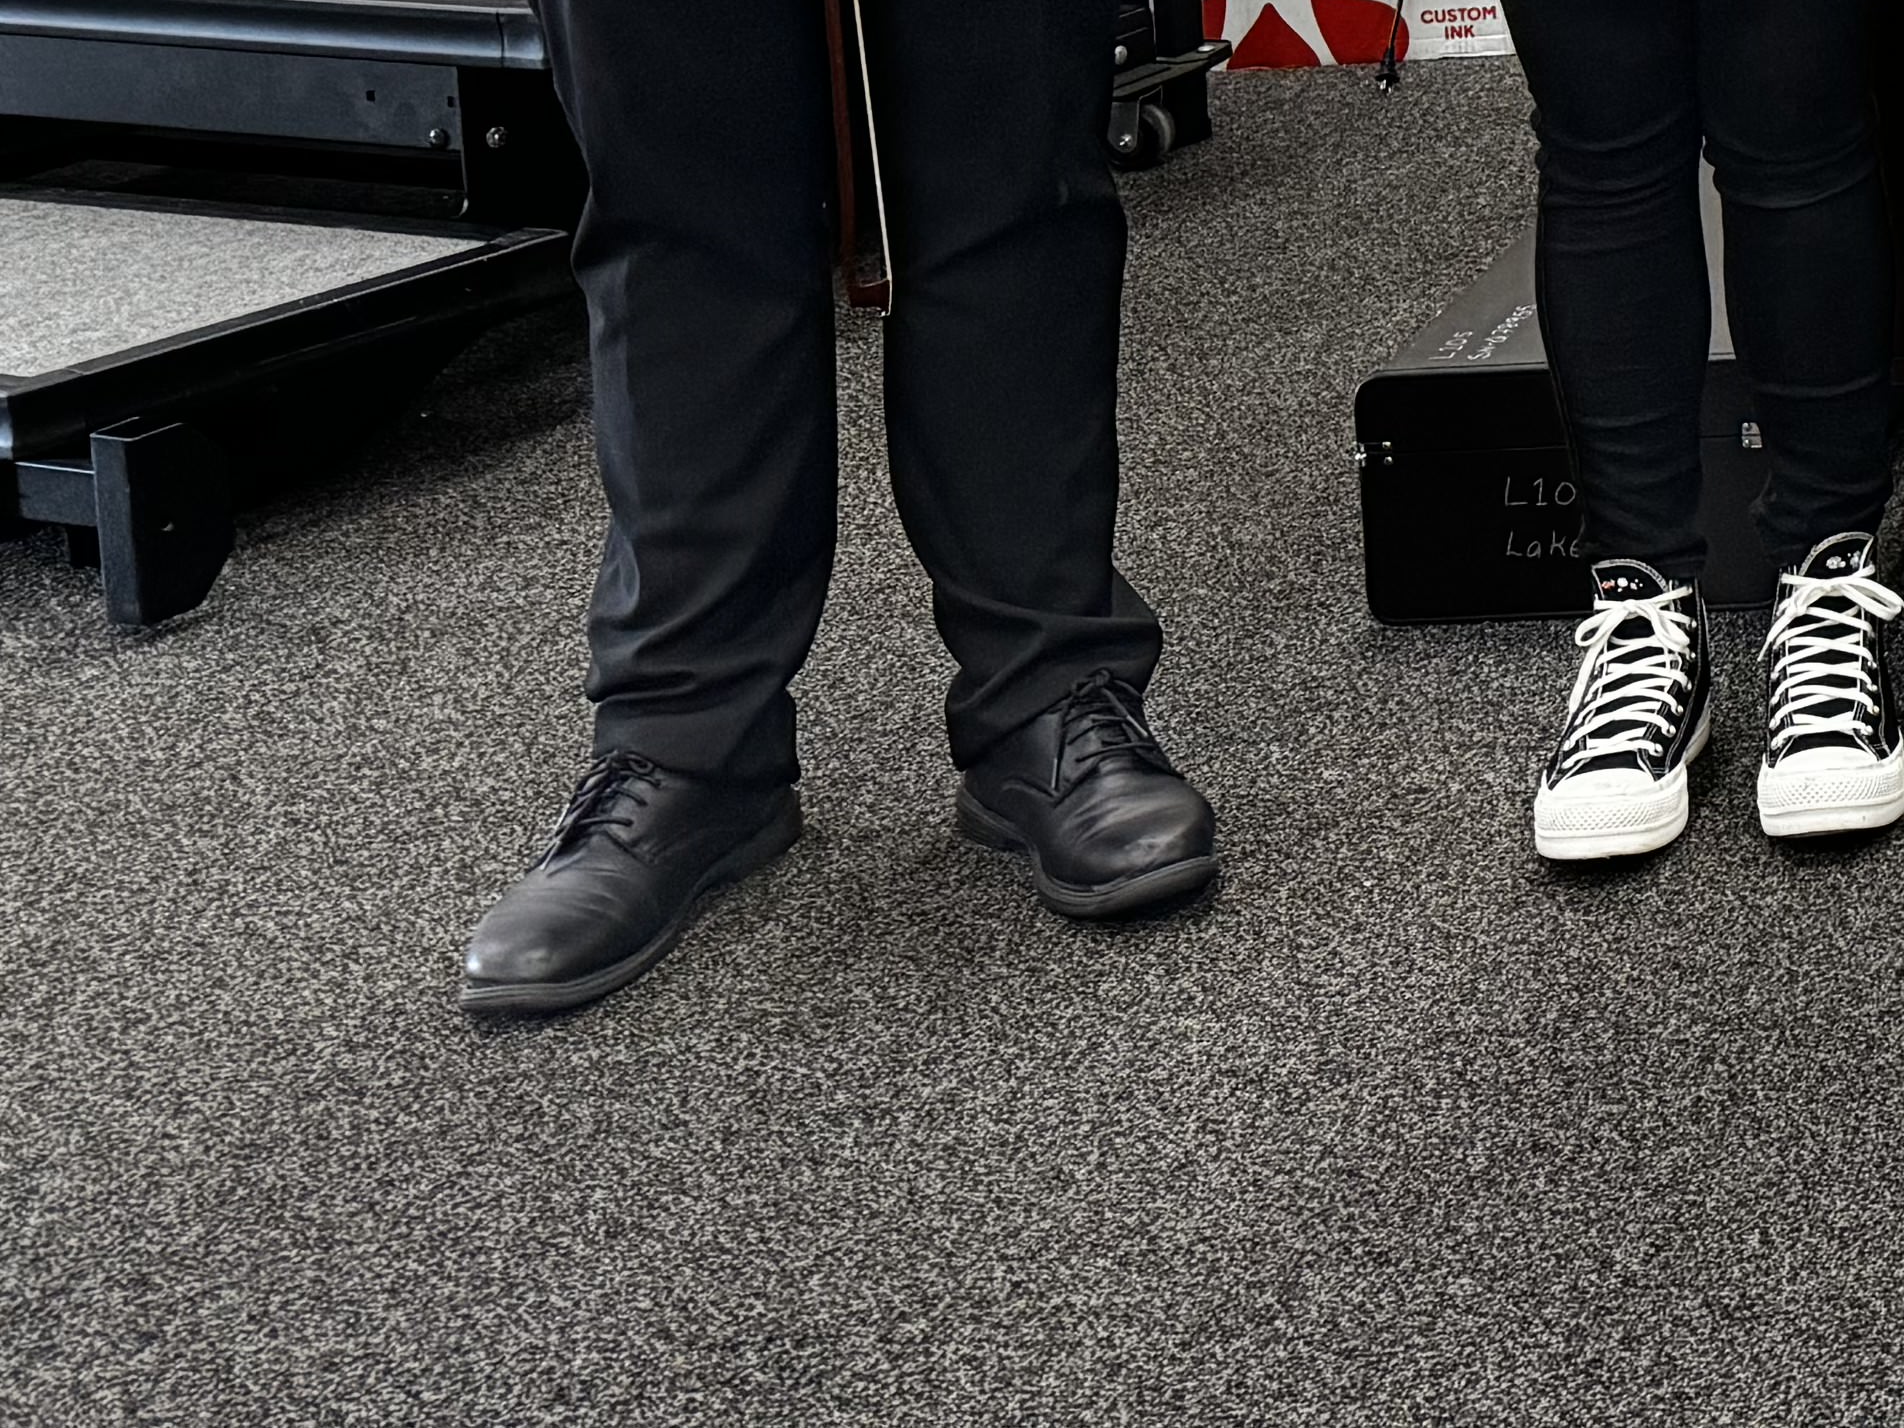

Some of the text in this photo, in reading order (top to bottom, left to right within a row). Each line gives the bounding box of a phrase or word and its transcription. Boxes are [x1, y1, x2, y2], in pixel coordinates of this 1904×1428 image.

[1421, 6, 1497, 24] CUSTOM
[1445, 25, 1475, 40] INK
[1505, 476, 1576, 506] L10
